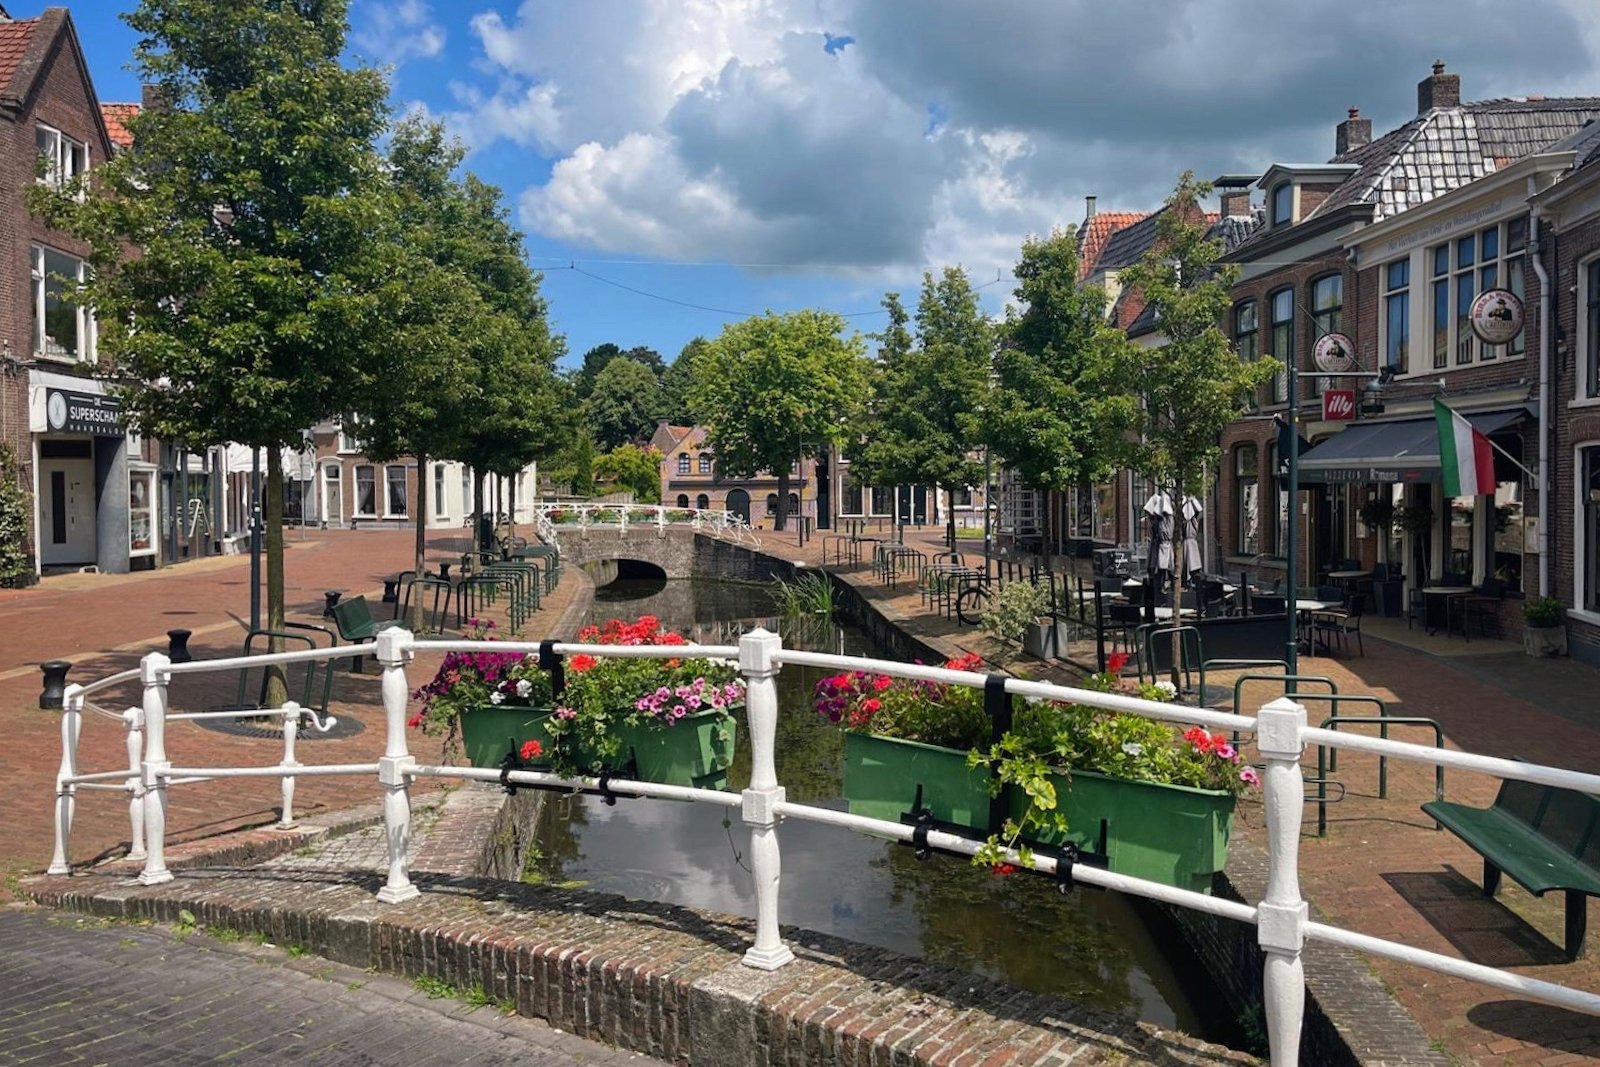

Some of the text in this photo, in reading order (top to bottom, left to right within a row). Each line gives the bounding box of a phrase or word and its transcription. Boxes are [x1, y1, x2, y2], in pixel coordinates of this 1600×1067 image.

[1475, 294, 1495, 319] BIRRA
[94, 397, 102, 407] DE
[1328, 394, 1353, 417] illy
